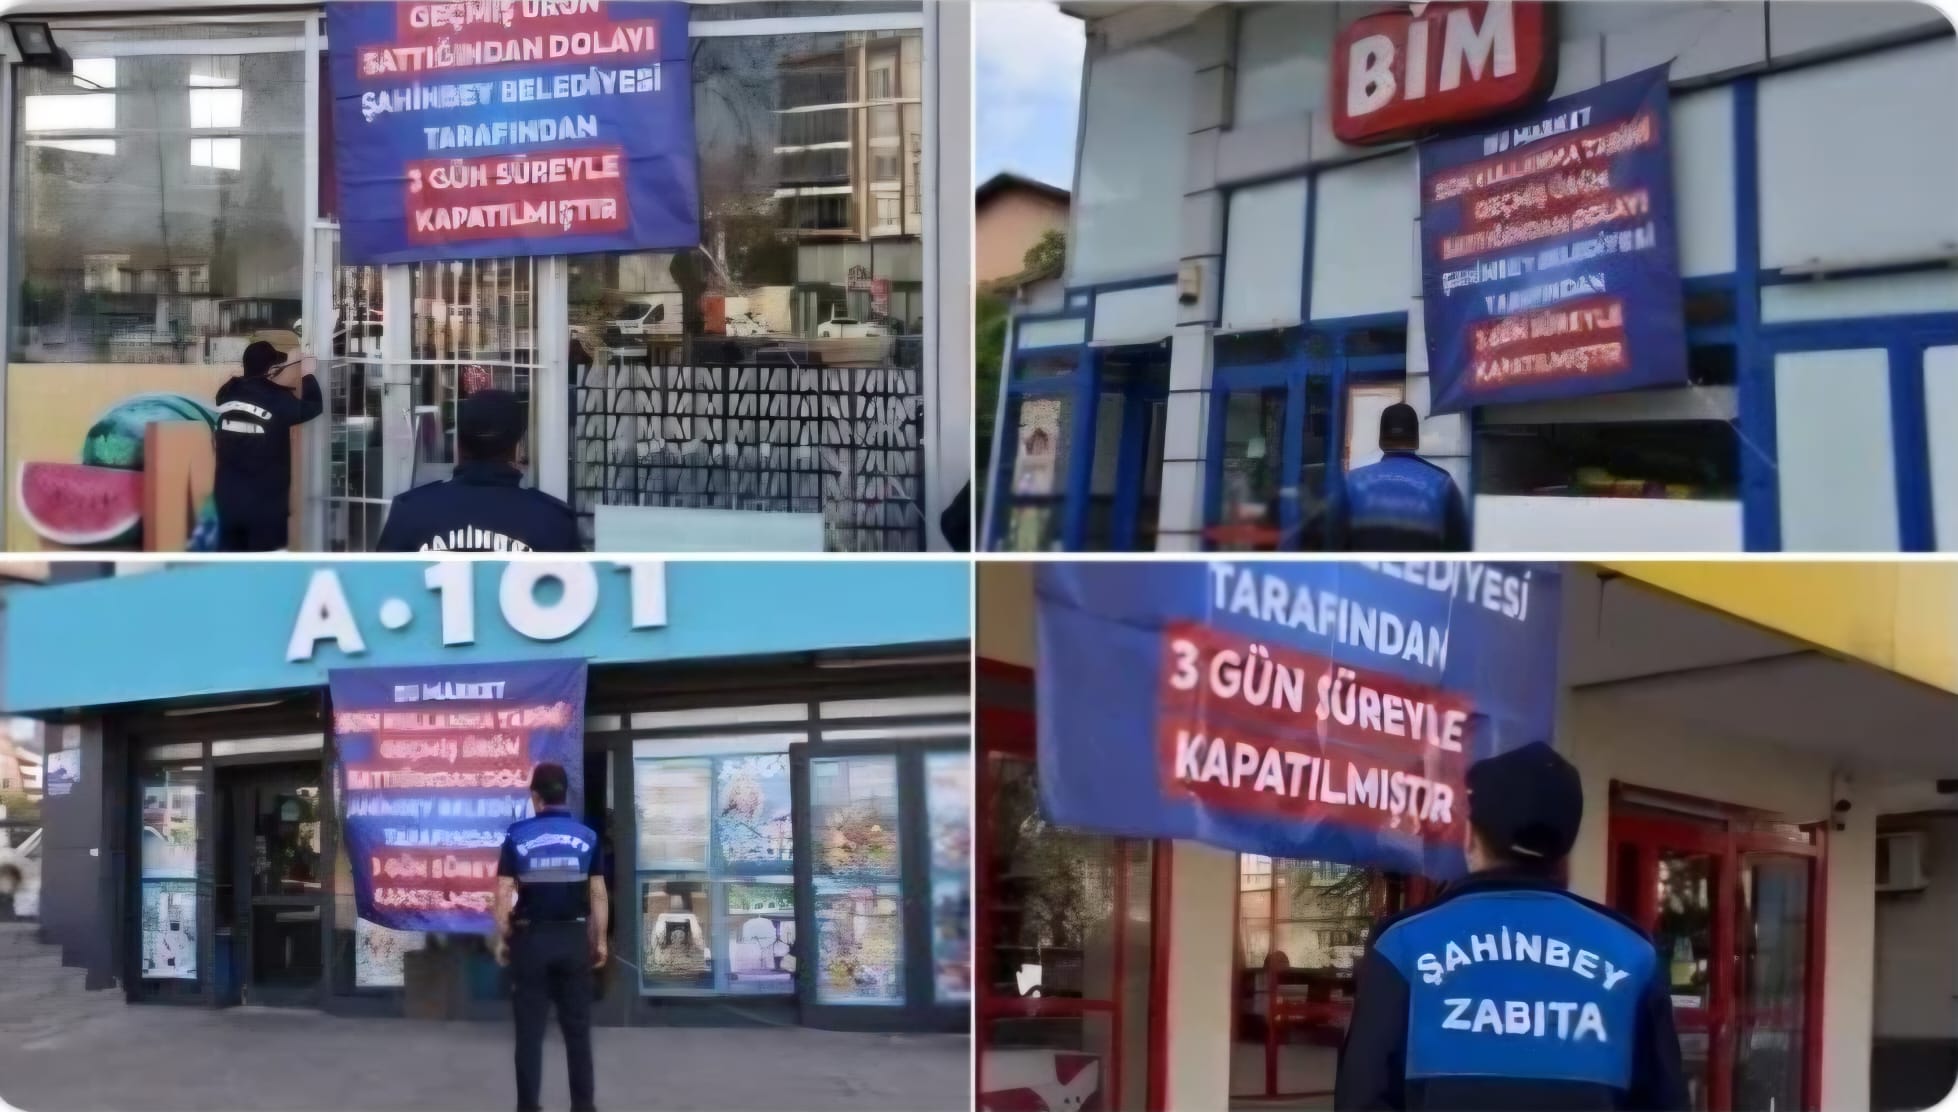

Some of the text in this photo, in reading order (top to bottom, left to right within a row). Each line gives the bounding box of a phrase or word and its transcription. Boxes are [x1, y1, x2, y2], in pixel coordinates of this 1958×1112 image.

[362, 26, 655, 76] SATTIĞINDAN DOLAYI
[1347, 0, 1517, 117] BİM
[501, 62, 662, 103] BELEDİYESİ
[424, 114, 598, 150] TARAFINDAN
[408, 154, 621, 193] 3 GÜN SÜREYLE
[415, 198, 618, 231] KAPATILMIŞTIR
[1208, 562, 1450, 672] TARAFINDAN
[1169, 639, 1468, 754] 3 GÜN SÜREYLE
[1175, 730, 1455, 829] KAPATILMIŞTIR
[1416, 925, 1632, 991] ŞAHİNBEY
[1441, 997, 1609, 1043] ZABITA
